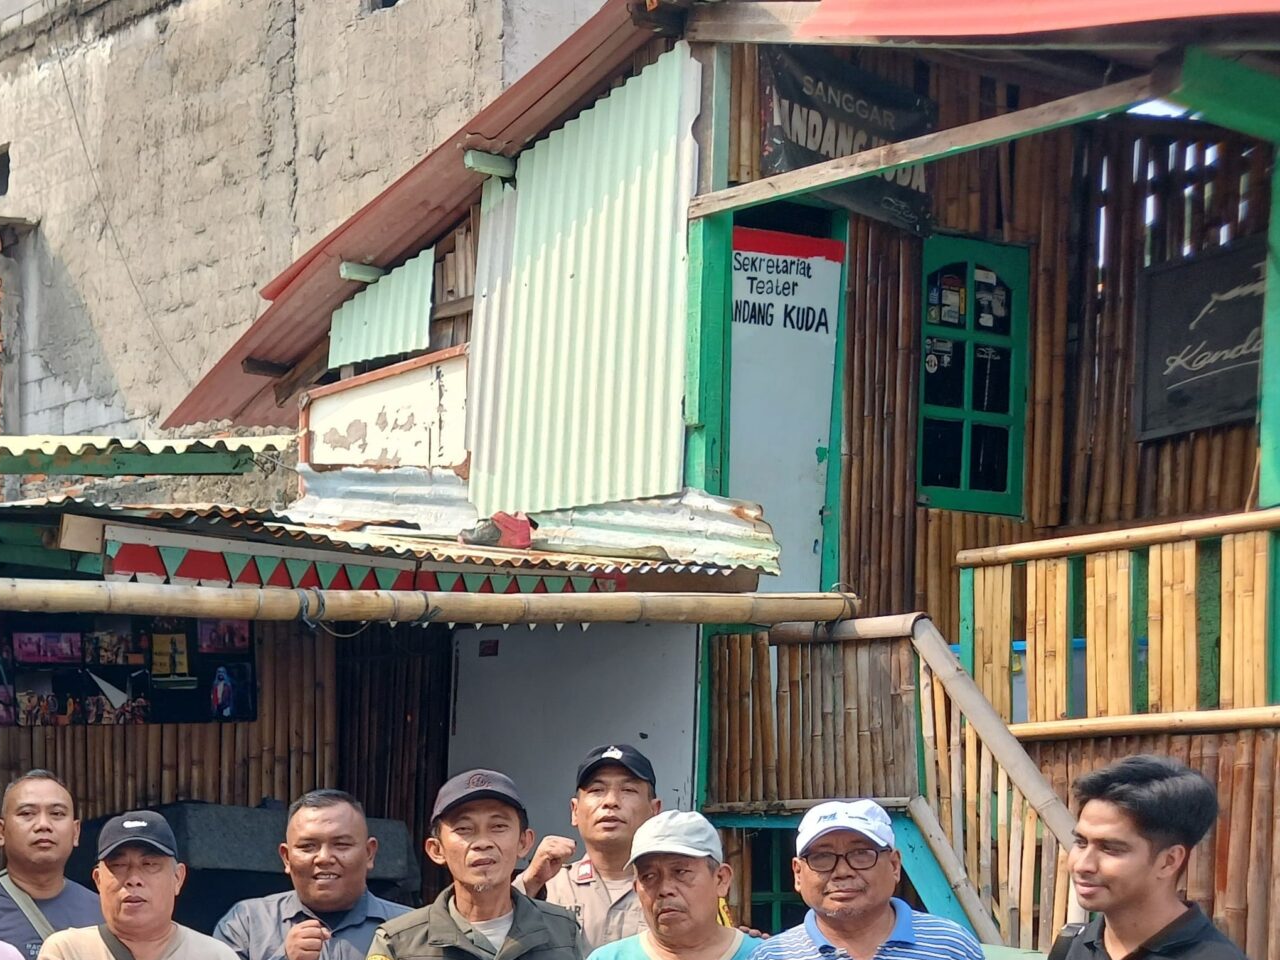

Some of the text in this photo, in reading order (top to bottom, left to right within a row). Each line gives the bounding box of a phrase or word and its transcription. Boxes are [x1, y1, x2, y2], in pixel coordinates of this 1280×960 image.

[802, 75, 896, 131] SANGGAR
[733, 252, 812, 279] Sekretariat
[746, 276, 799, 297] Teater
[732, 299, 829, 335] NDANG KUDA
